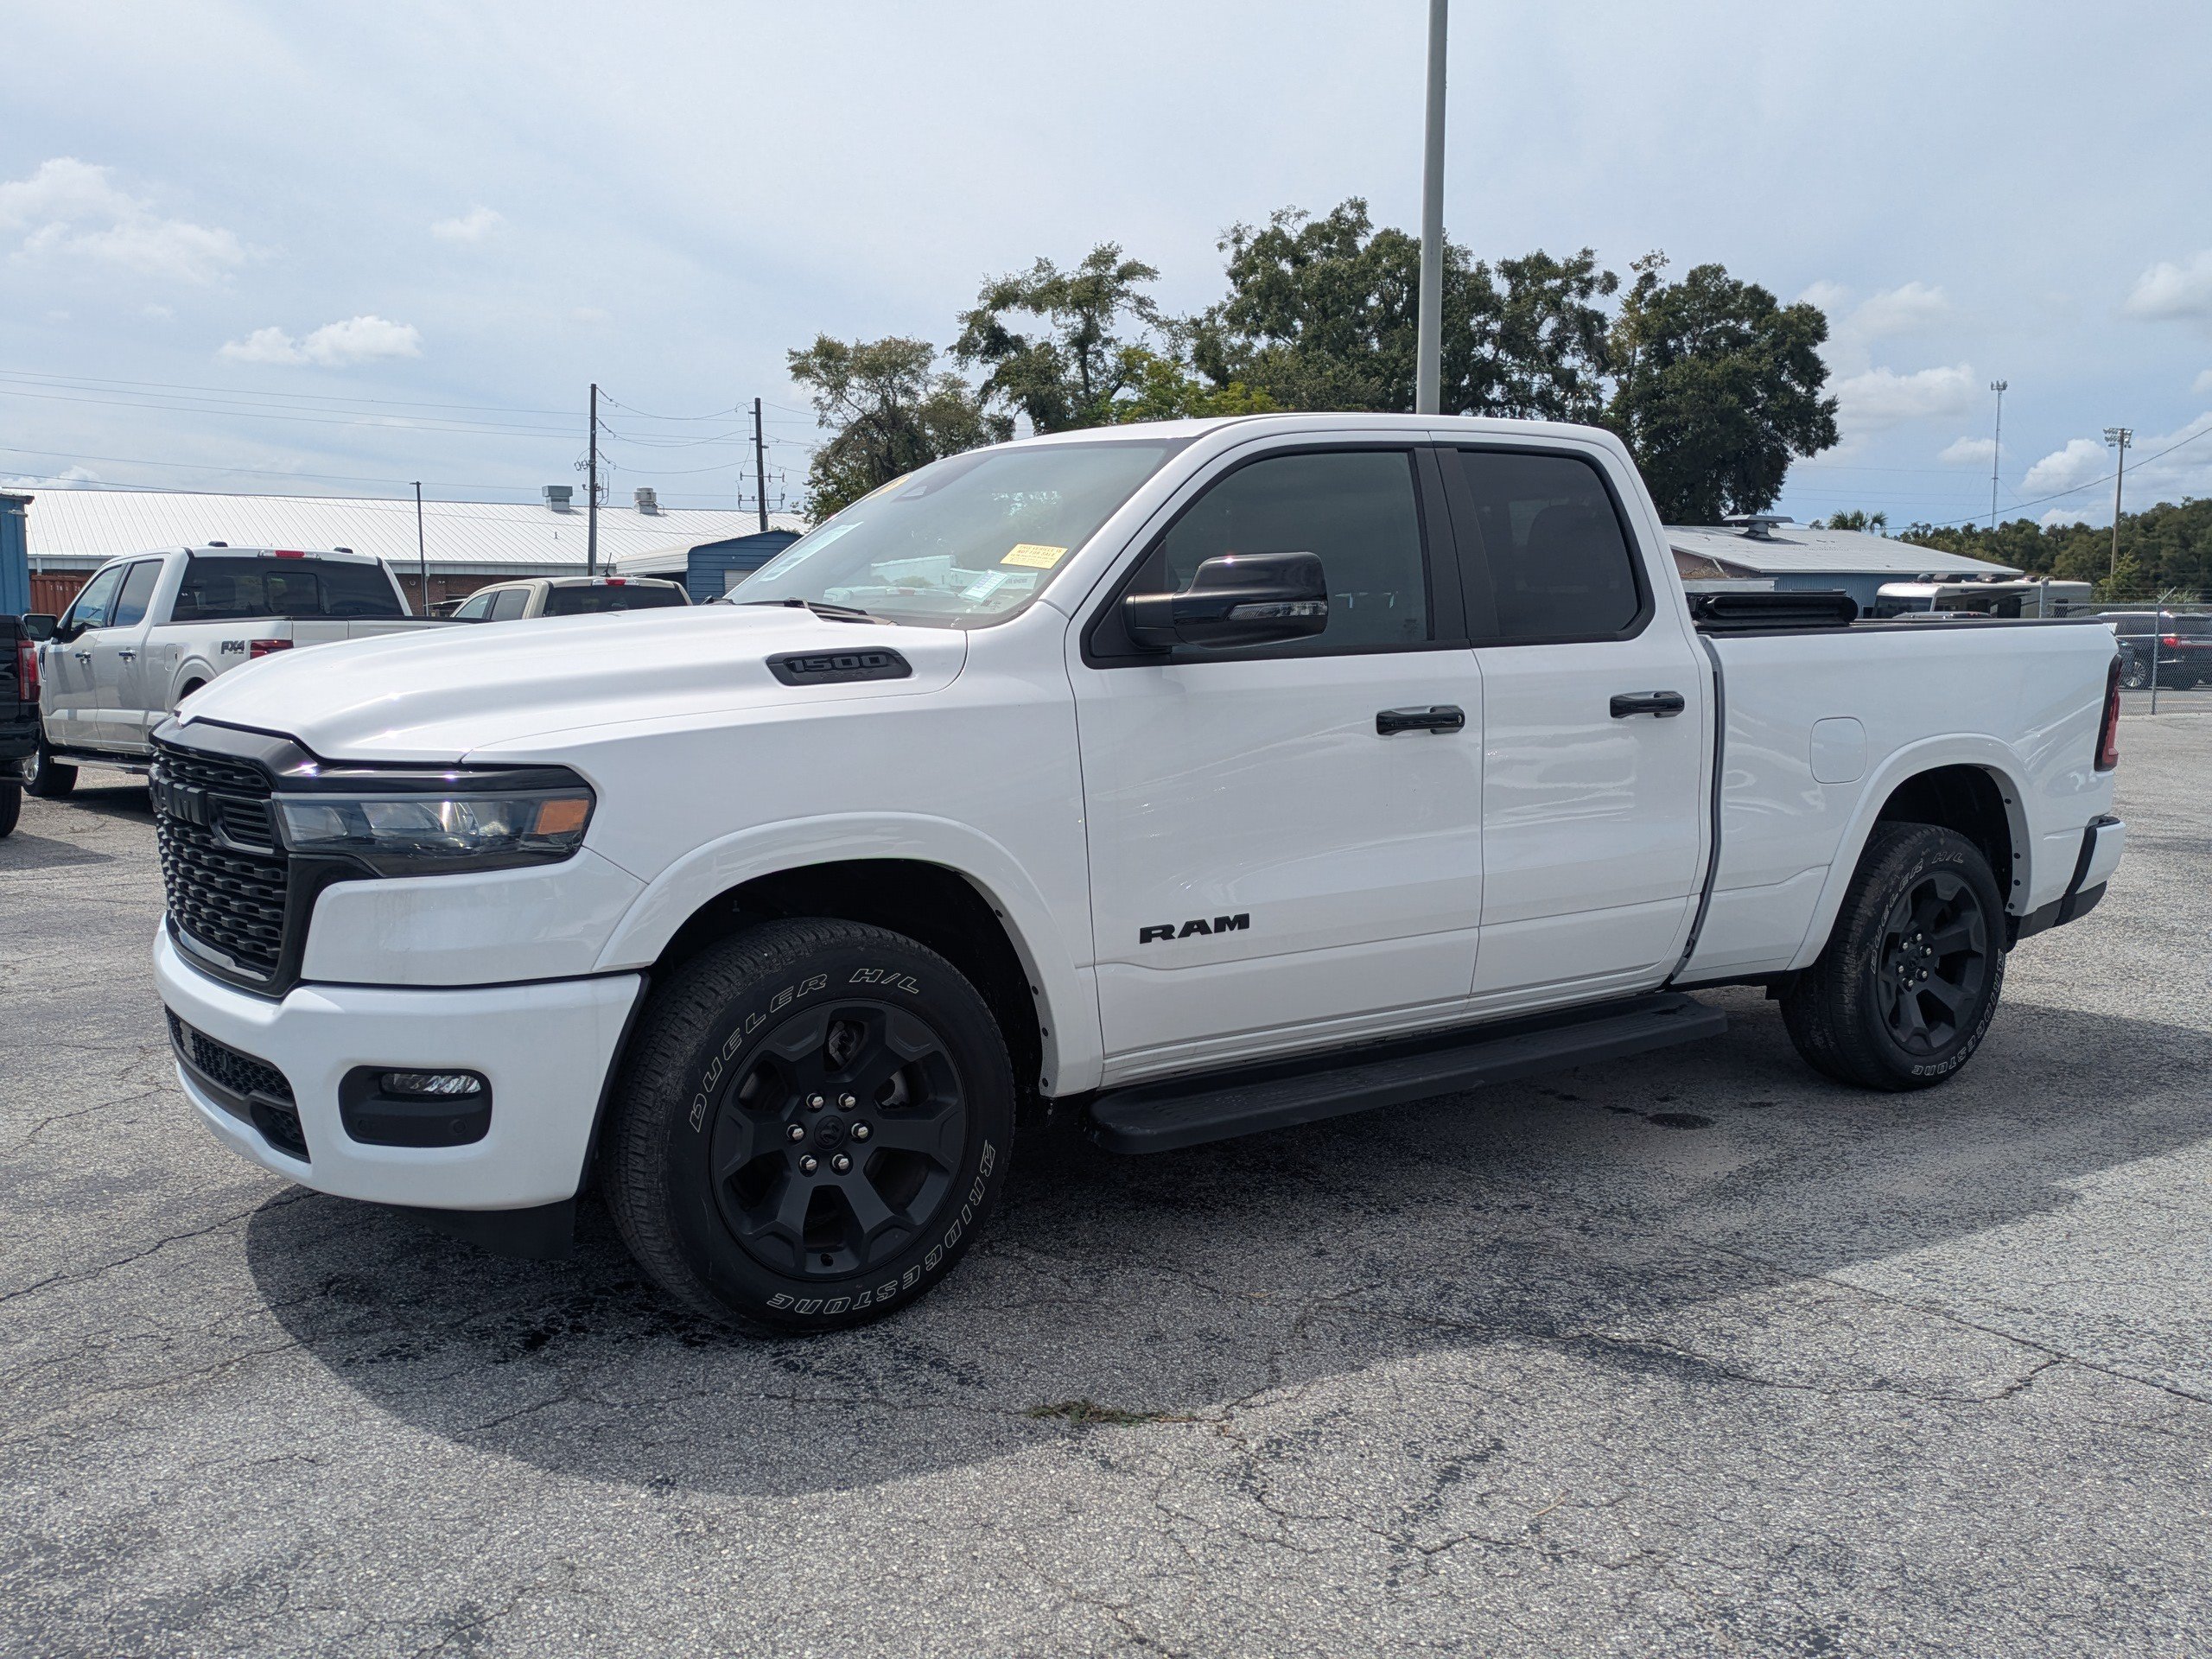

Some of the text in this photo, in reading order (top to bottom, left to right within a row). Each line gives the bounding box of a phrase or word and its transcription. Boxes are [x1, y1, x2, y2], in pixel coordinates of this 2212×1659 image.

[220, 640, 245, 654] FX4
[790, 654, 888, 672] 1500
[1931, 850, 1964, 864] H/L
[1140, 913, 1249, 944] RAM
[1911, 948, 2005, 1077] BRIDGESTONE
[690, 969, 919, 1133] DUELER H/L
[766, 1140, 995, 1314] BRIDGESTONE
